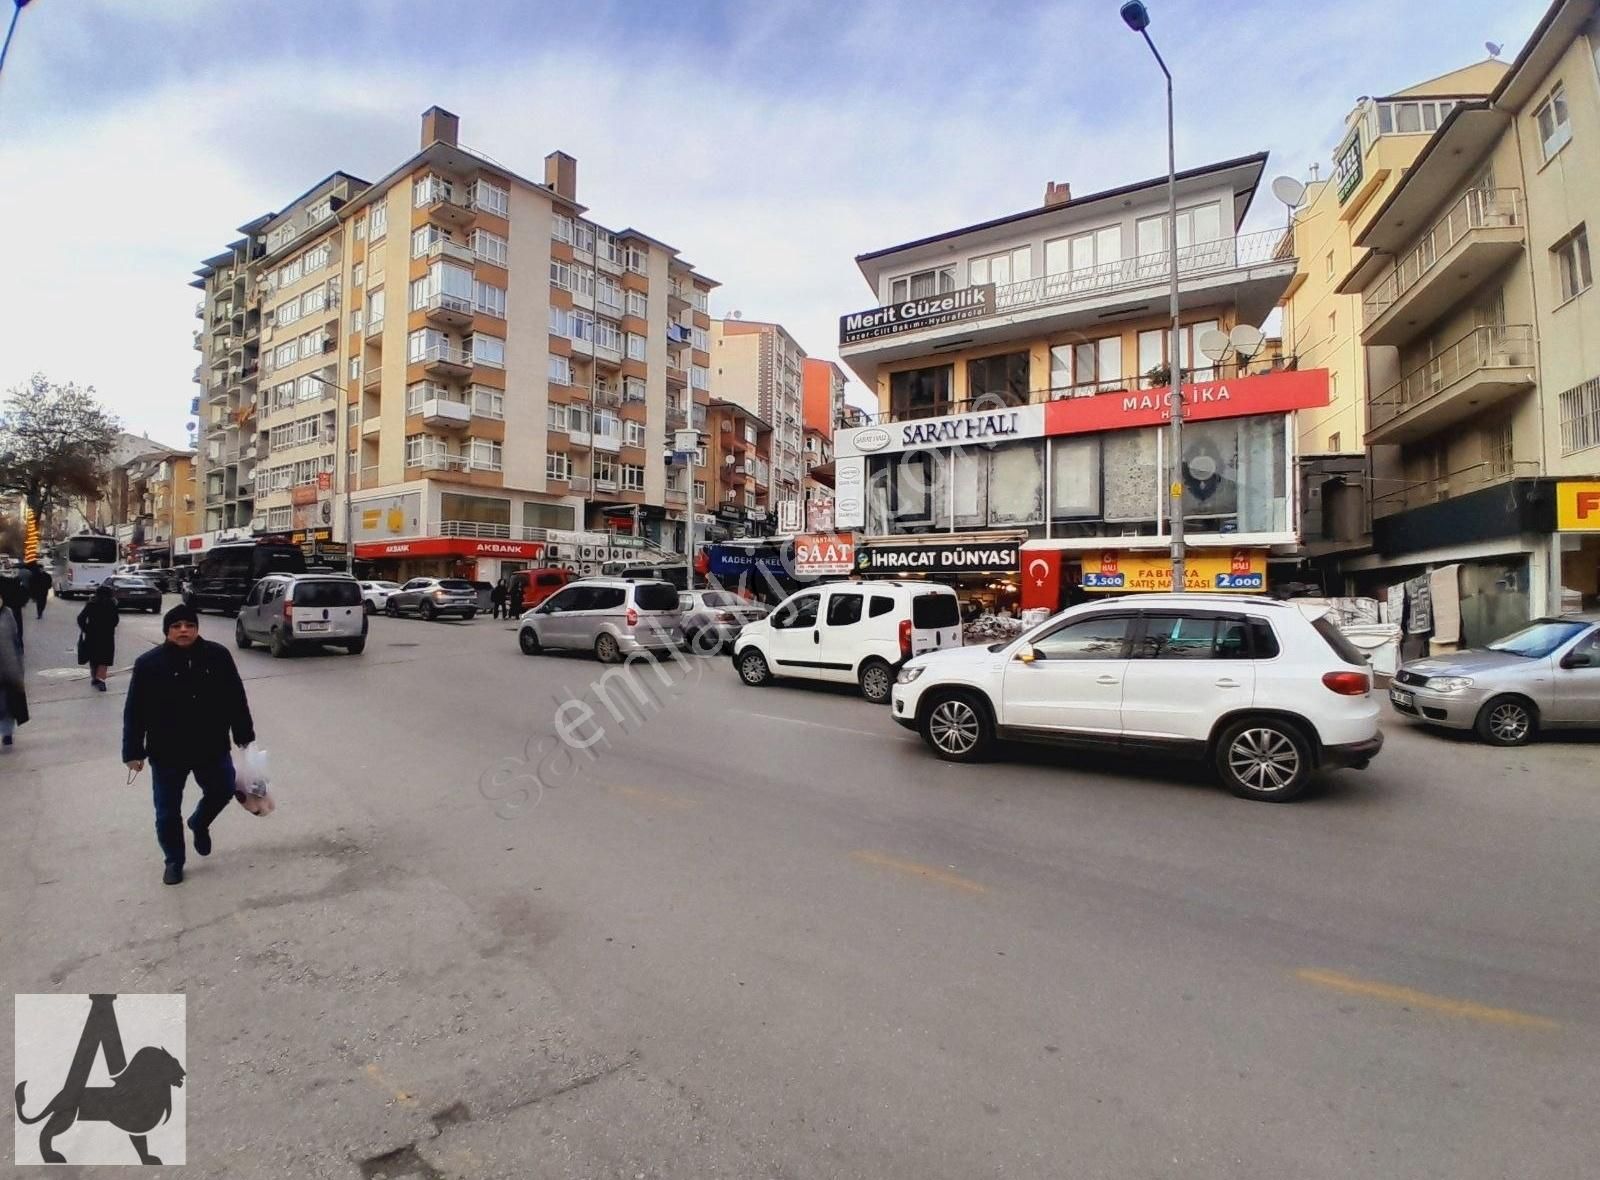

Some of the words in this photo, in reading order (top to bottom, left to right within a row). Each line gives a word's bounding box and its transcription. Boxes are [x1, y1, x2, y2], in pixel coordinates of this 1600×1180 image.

[846, 309, 896, 331] Merit
[900, 288, 985, 319] Güzellik
[386, 544, 409, 553] AKBANK
[476, 543, 521, 553] AKBANK
[796, 543, 851, 562] SAAT
[872, 549, 936, 567] İHRACAT
[941, 547, 1015, 566] DÜNYASI
[1087, 573, 1122, 585] 3.500
[1130, 580, 1156, 590] SATIŞ
[1219, 573, 1260, 586] 2.000
